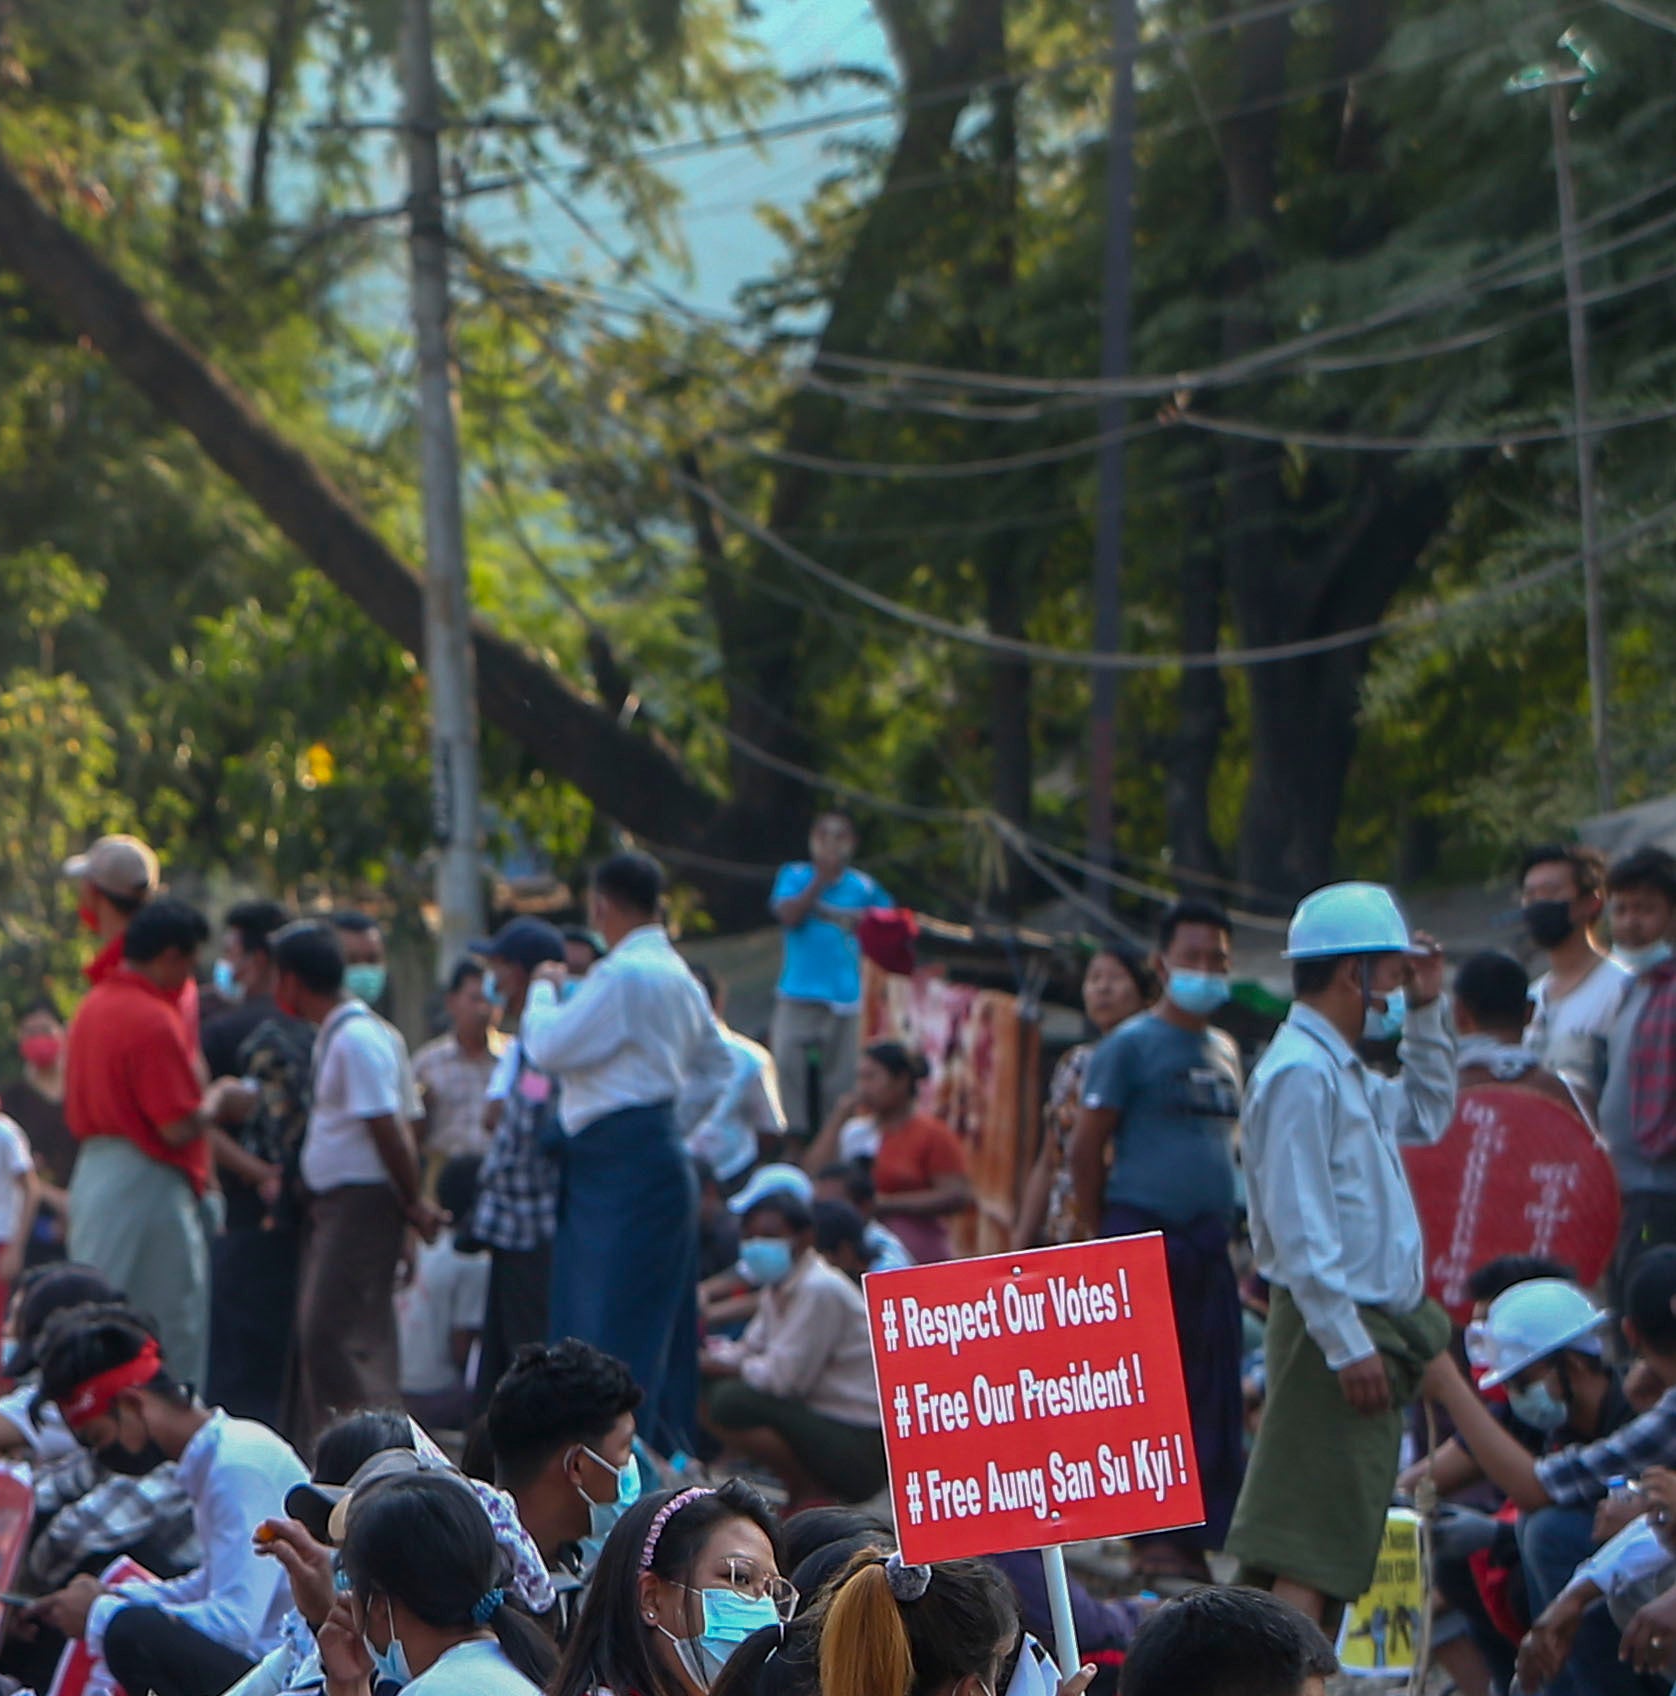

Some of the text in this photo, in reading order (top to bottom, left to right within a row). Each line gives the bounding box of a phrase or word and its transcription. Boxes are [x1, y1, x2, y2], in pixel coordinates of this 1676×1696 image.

[881, 1268, 1132, 1356] # Respect Our Votes !
[893, 1353, 1146, 1439] # Free Our President !
[906, 1434, 1188, 1525] # Free Aung San Su Kyi !
